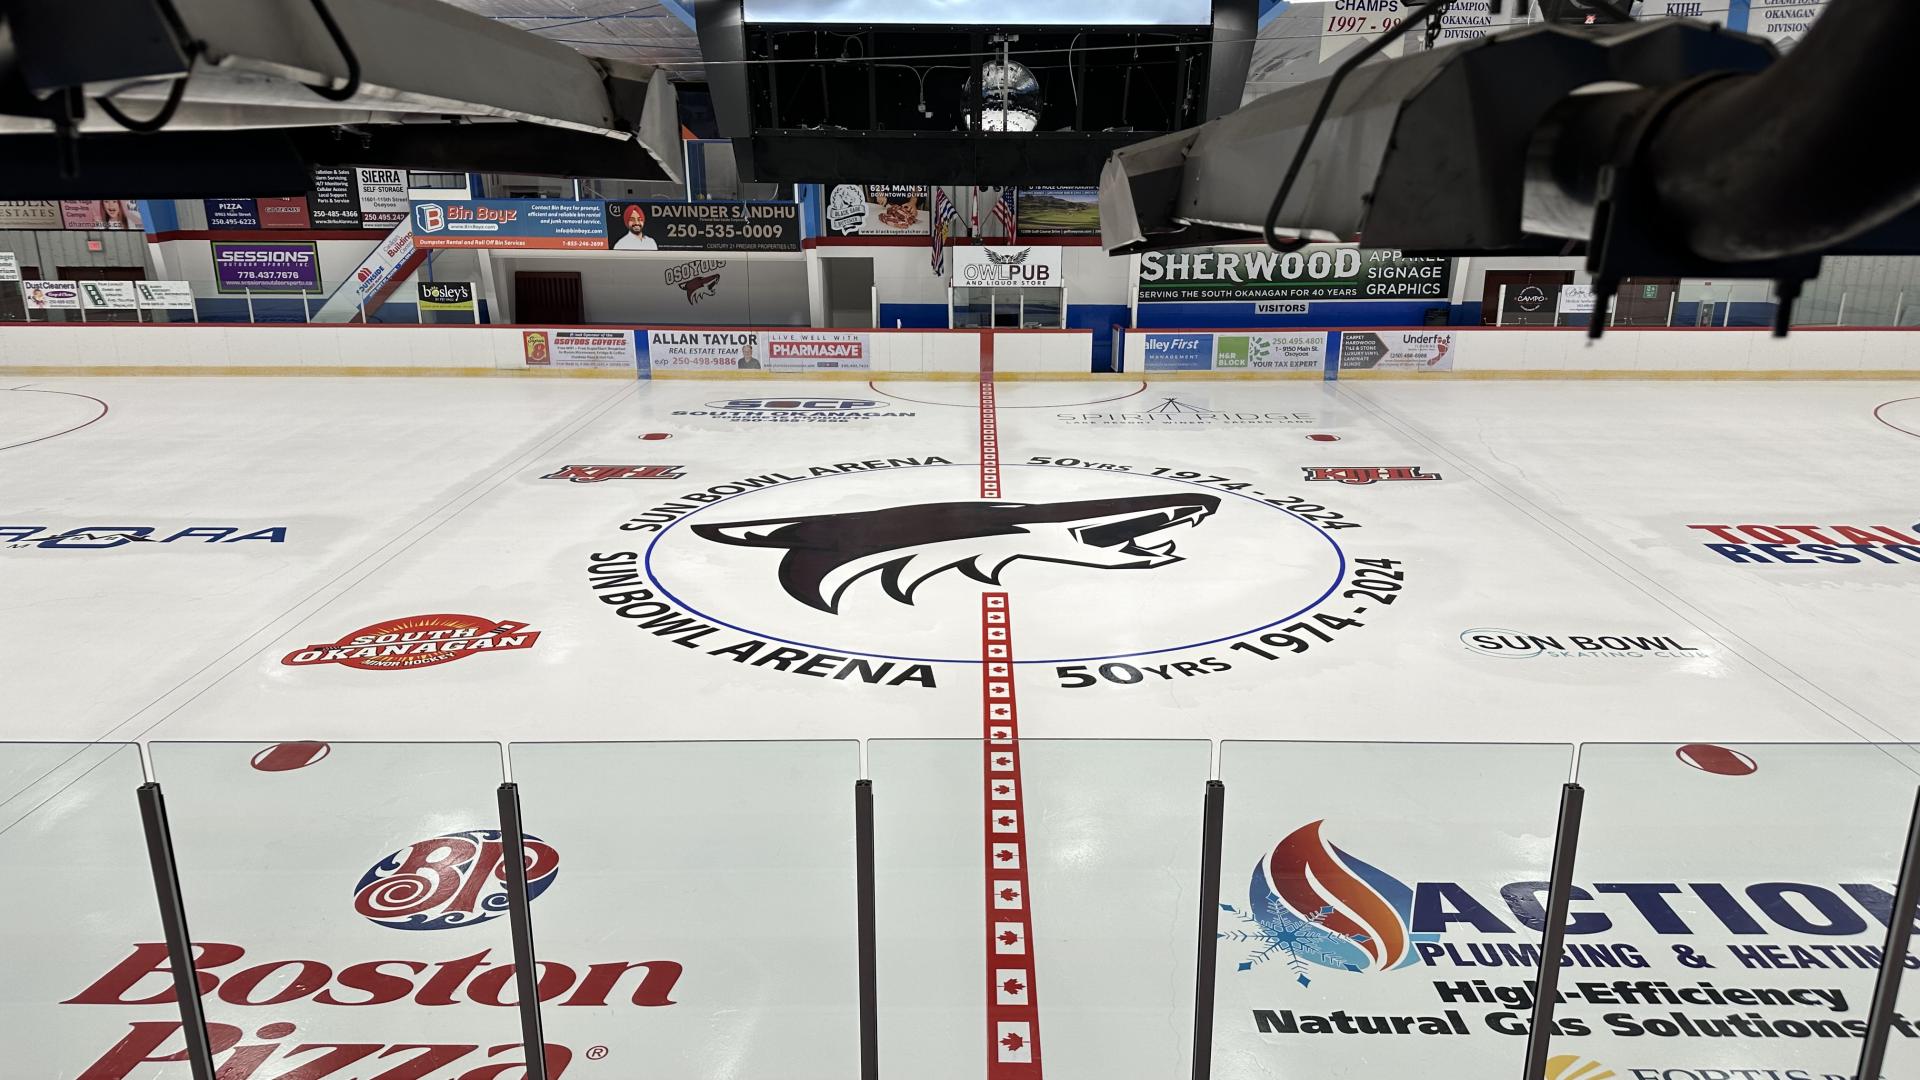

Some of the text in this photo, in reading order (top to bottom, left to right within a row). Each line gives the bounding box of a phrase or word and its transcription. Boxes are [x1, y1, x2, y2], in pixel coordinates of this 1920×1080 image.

[1335, 0, 1398, 12] CHAMPS
[1442, 16, 1492, 25] OKANAGAN
[1765, 9, 1815, 19] OKANAGAN
[1327, 16, 1367, 33] 1997
[1767, 23, 1810, 33] DIVISION
[1444, 30, 1488, 39] DIVISION
[361, 170, 401, 183] SIERRA
[870, 184, 890, 192] 6234
[447, 204, 518, 224] Bin Boyz
[651, 206, 796, 218] DAVINDER SANDHU
[666, 223, 783, 238] 250-535-0009
[221, 251, 310, 262] SESSIONS
[1139, 248, 1362, 283] SHERWOOD
[1367, 266, 1442, 279] SIGNAGE
[422, 284, 468, 301] bosley's
[1182, 290, 1199, 298] THE
[1201, 290, 1232, 298] SOUTH
[1234, 289, 1288, 298] OKANAGAN
[1290, 289, 1309, 297] FOR
[1312, 289, 1324, 297] 40
[1326, 289, 1358, 297] YEARS
[1366, 282, 1441, 295] GRAPHICS
[1258, 304, 1306, 313] VISITORS
[652, 333, 758, 345] ALLAN TAYLOR
[1171, 338, 1200, 350] First
[773, 344, 859, 356] PHARMASAVE
[672, 357, 737, 366] 250-498-9886
[1252, 360, 1273, 368] YOUR
[1056, 413, 1317, 421] SPIRIT RIDGE
[619, 456, 954, 532] SUN BOWL ARENA
[1343, 558, 1405, 606] 2024
[587, 551, 937, 689] SUN BOWL ARENA
[350, 627, 479, 646] SOUTH
[1472, 635, 1699, 650] SUN BOWL
[292, 635, 528, 663] OKANAGAN
[362, 652, 457, 668] MINOR HOCKEY
[1671, 943, 1717, 969] &
[58, 941, 684, 1007] Boston
[1252, 1009, 1471, 1036] Natural
[1603, 1011, 1867, 1038] Solutions
[75, 1021, 573, 1080] Pizza
